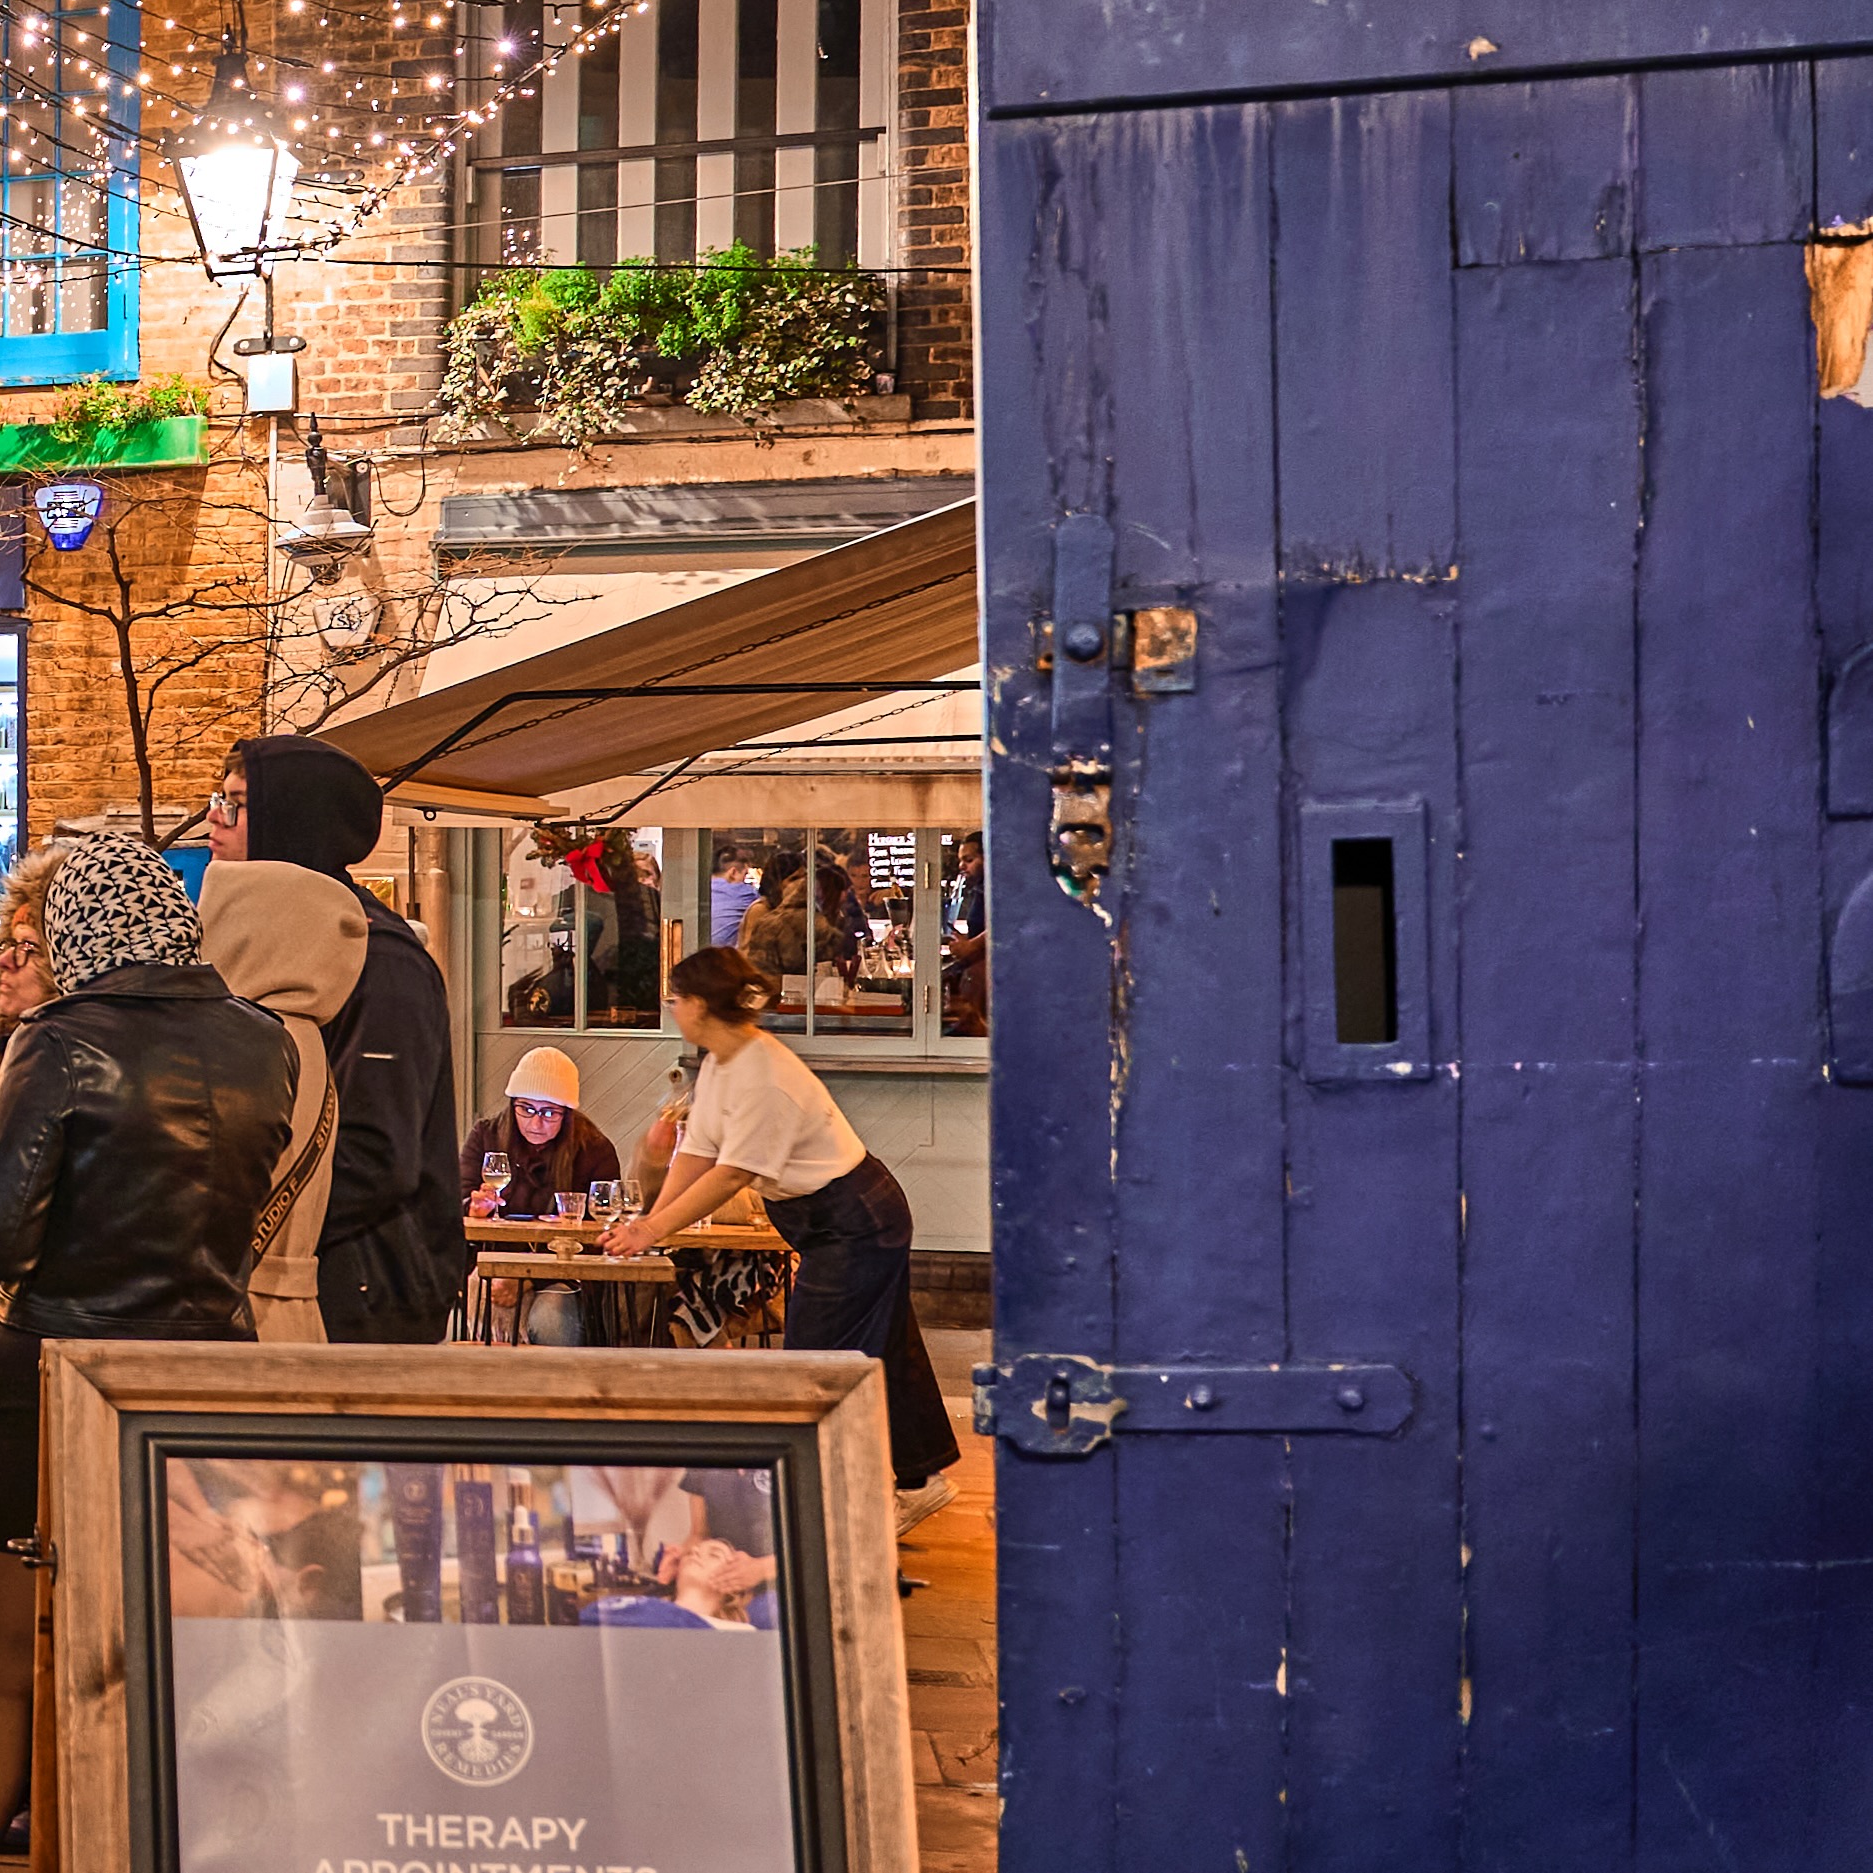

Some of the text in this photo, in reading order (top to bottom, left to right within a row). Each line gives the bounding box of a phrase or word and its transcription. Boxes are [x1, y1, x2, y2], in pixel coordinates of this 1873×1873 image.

[485, 1686, 523, 1728] YARD
[435, 1741, 522, 1778] REMEDIES
[376, 1813, 587, 1852] THERAPY
